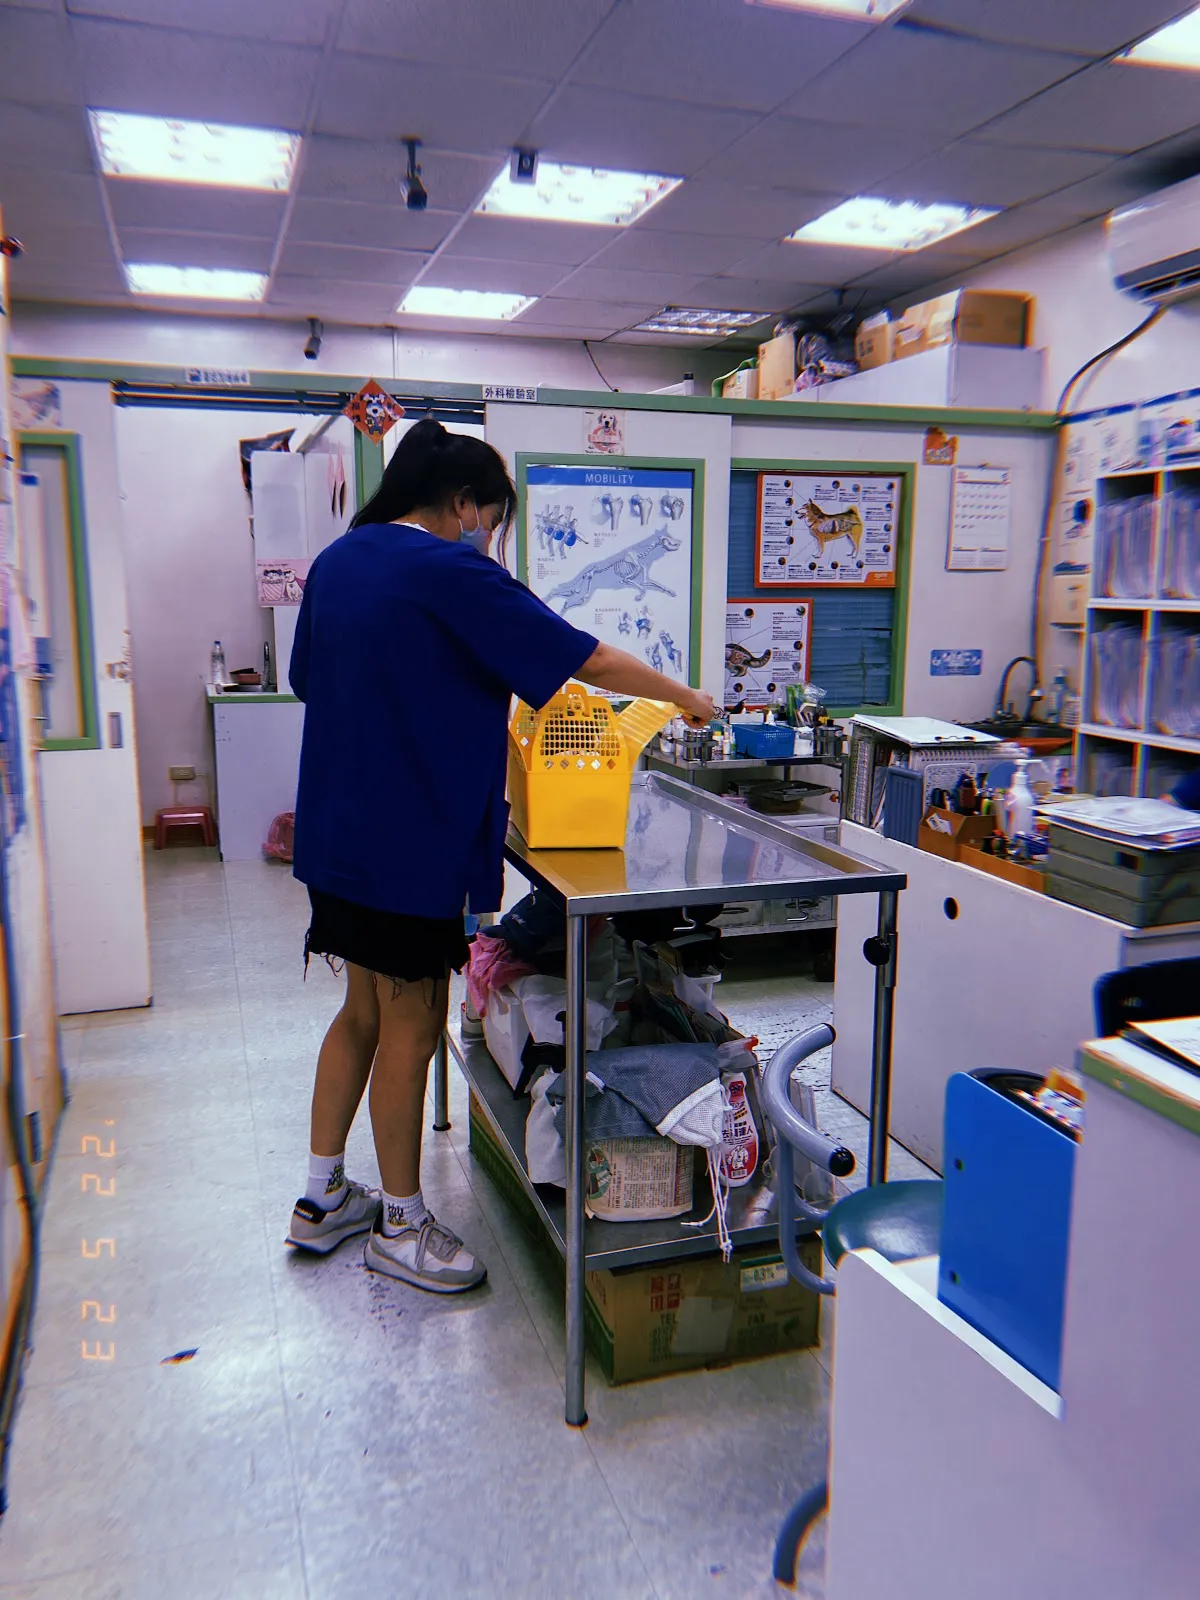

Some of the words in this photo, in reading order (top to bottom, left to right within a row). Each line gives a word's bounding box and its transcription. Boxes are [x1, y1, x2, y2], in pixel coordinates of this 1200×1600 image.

[485, 386, 536, 400] 外科檢驗室
[585, 473, 635, 484] MOBILITY
